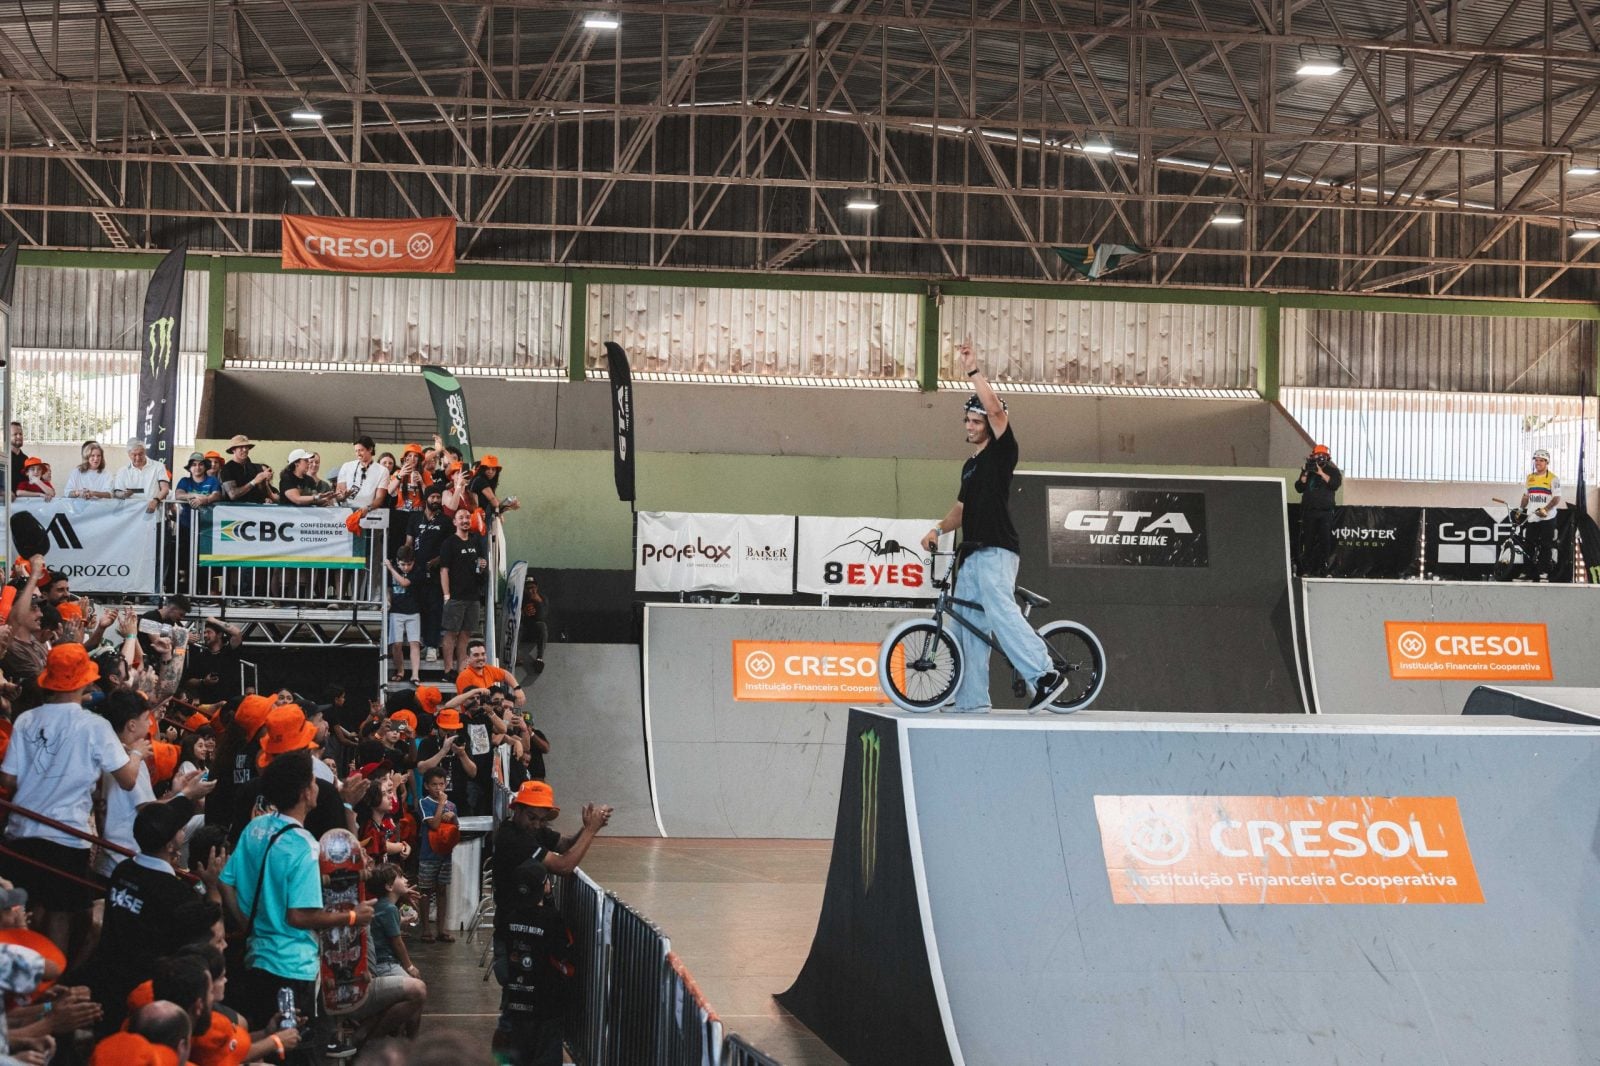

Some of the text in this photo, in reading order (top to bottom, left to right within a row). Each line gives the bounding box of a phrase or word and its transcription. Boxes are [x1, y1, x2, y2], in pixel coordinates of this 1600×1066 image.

[304, 235, 403, 258] CRESOL
[617, 385, 627, 462] GTA
[240, 520, 295, 542] CBC
[1064, 510, 1193, 534] GTA
[1089, 534, 1168, 546] VOCÊ DE BIKE
[1331, 526, 1396, 540] MONSTER
[60, 565, 130, 577] OROZCO
[1434, 636, 1538, 656] CRESOL
[784, 655, 877, 677] CRESO
[1400, 662, 1444, 671] Instituição
[1490, 663, 1541, 671] Cooperativa
[745, 683, 791, 692] Instituição
[794, 683, 838, 692] Financeira
[1210, 820, 1448, 858] CRESOL
[1237, 873, 1336, 887] Financeira
[1339, 873, 1457, 889] Cooperativa
